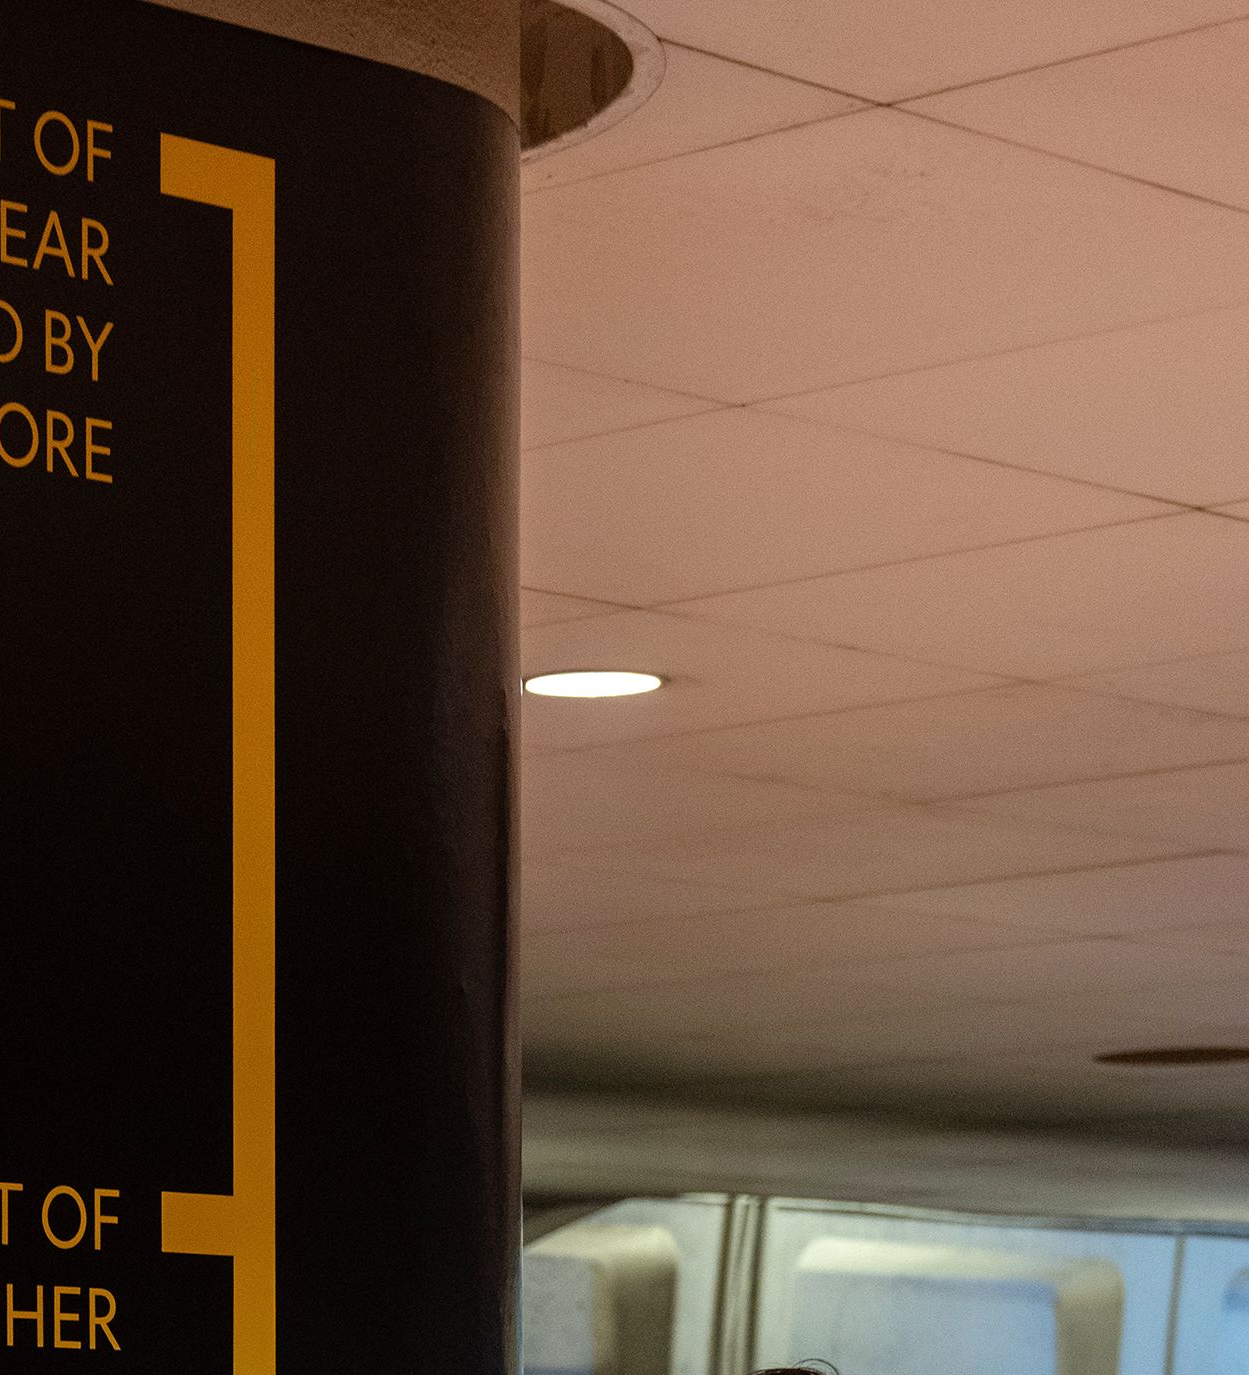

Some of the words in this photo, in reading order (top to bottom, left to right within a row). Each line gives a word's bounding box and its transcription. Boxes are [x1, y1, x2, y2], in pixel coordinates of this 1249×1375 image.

[33, 110, 114, 182] OF
[44, 308, 114, 382] BY
[41, 1184, 120, 1251] OF
